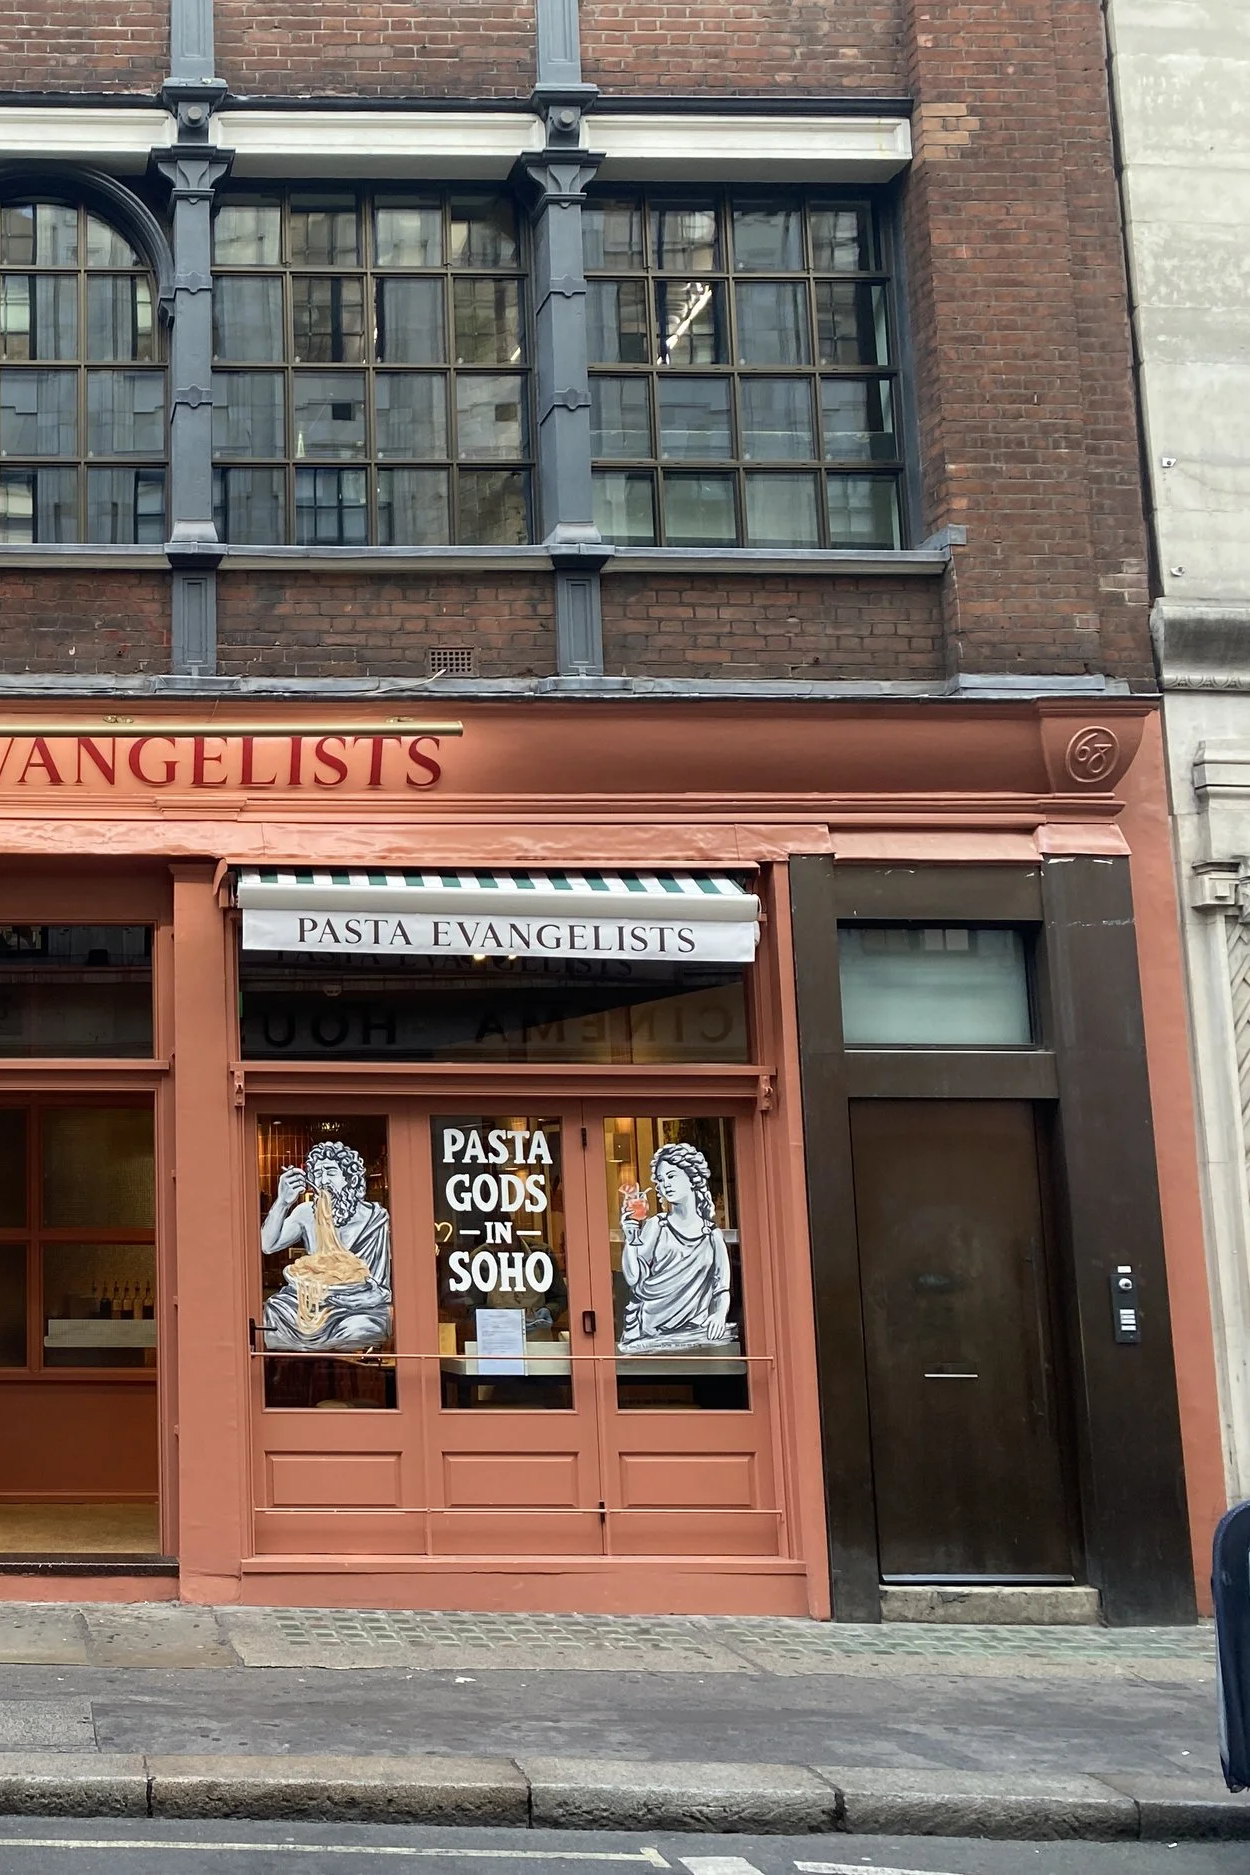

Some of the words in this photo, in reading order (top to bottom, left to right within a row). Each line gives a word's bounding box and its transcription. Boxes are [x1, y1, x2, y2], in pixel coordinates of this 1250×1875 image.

[297, 917, 413, 946] PASTA
[432, 921, 696, 953] EVANGELISTS
[442, 1128, 554, 1164] PASTA
[445, 1173, 548, 1213] GODS
[448, 1250, 554, 1293] SOHO
